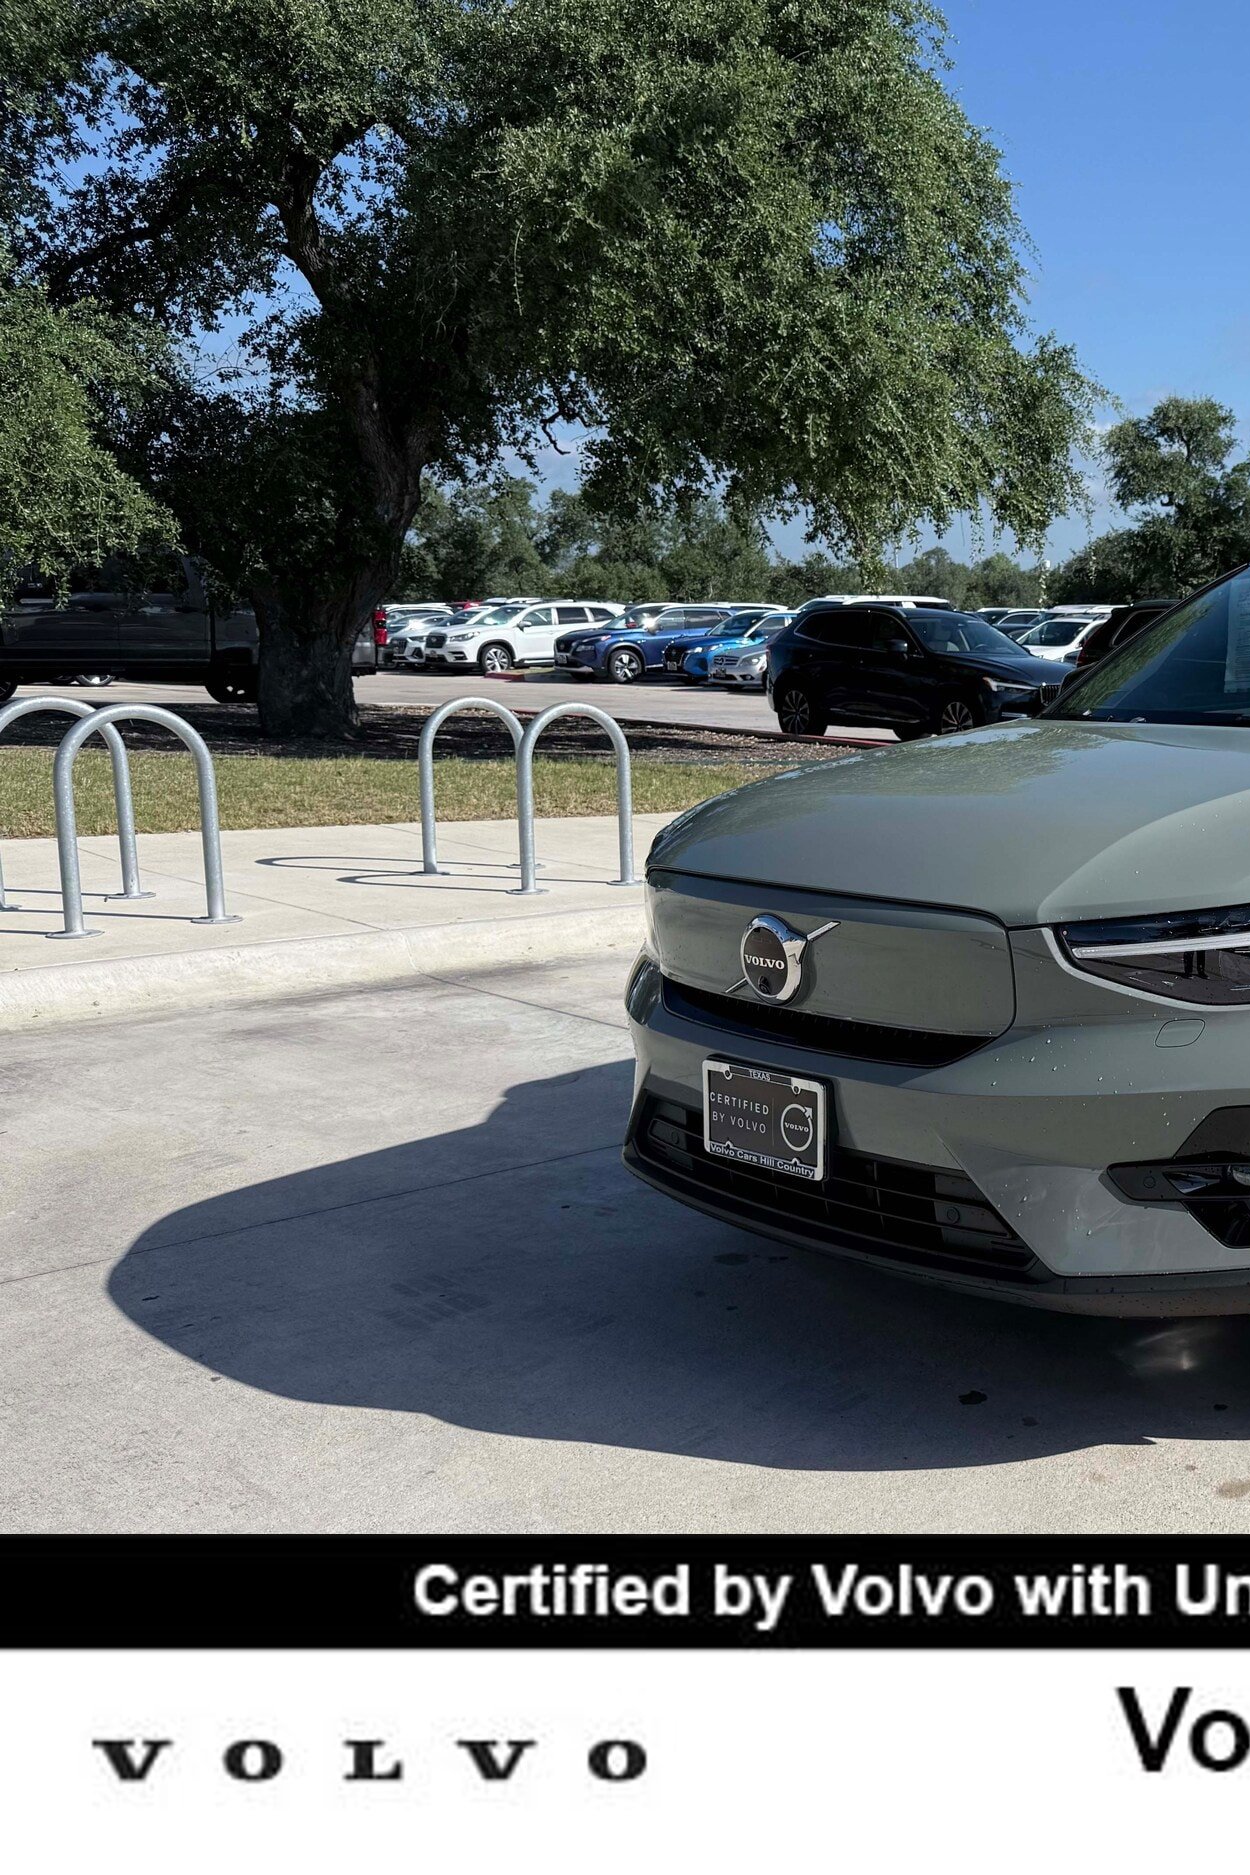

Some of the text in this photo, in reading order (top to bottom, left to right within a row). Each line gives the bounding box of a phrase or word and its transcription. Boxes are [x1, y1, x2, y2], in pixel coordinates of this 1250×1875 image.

[744, 954, 785, 970] VOLVO
[750, 1070, 771, 1082] TEXAS
[709, 1091, 769, 1115] CERTIFIED
[712, 1111, 766, 1134] BY VOLVO
[784, 1121, 809, 1133] VOLVO
[710, 1143, 814, 1178] Volvo Cars Hill Country
